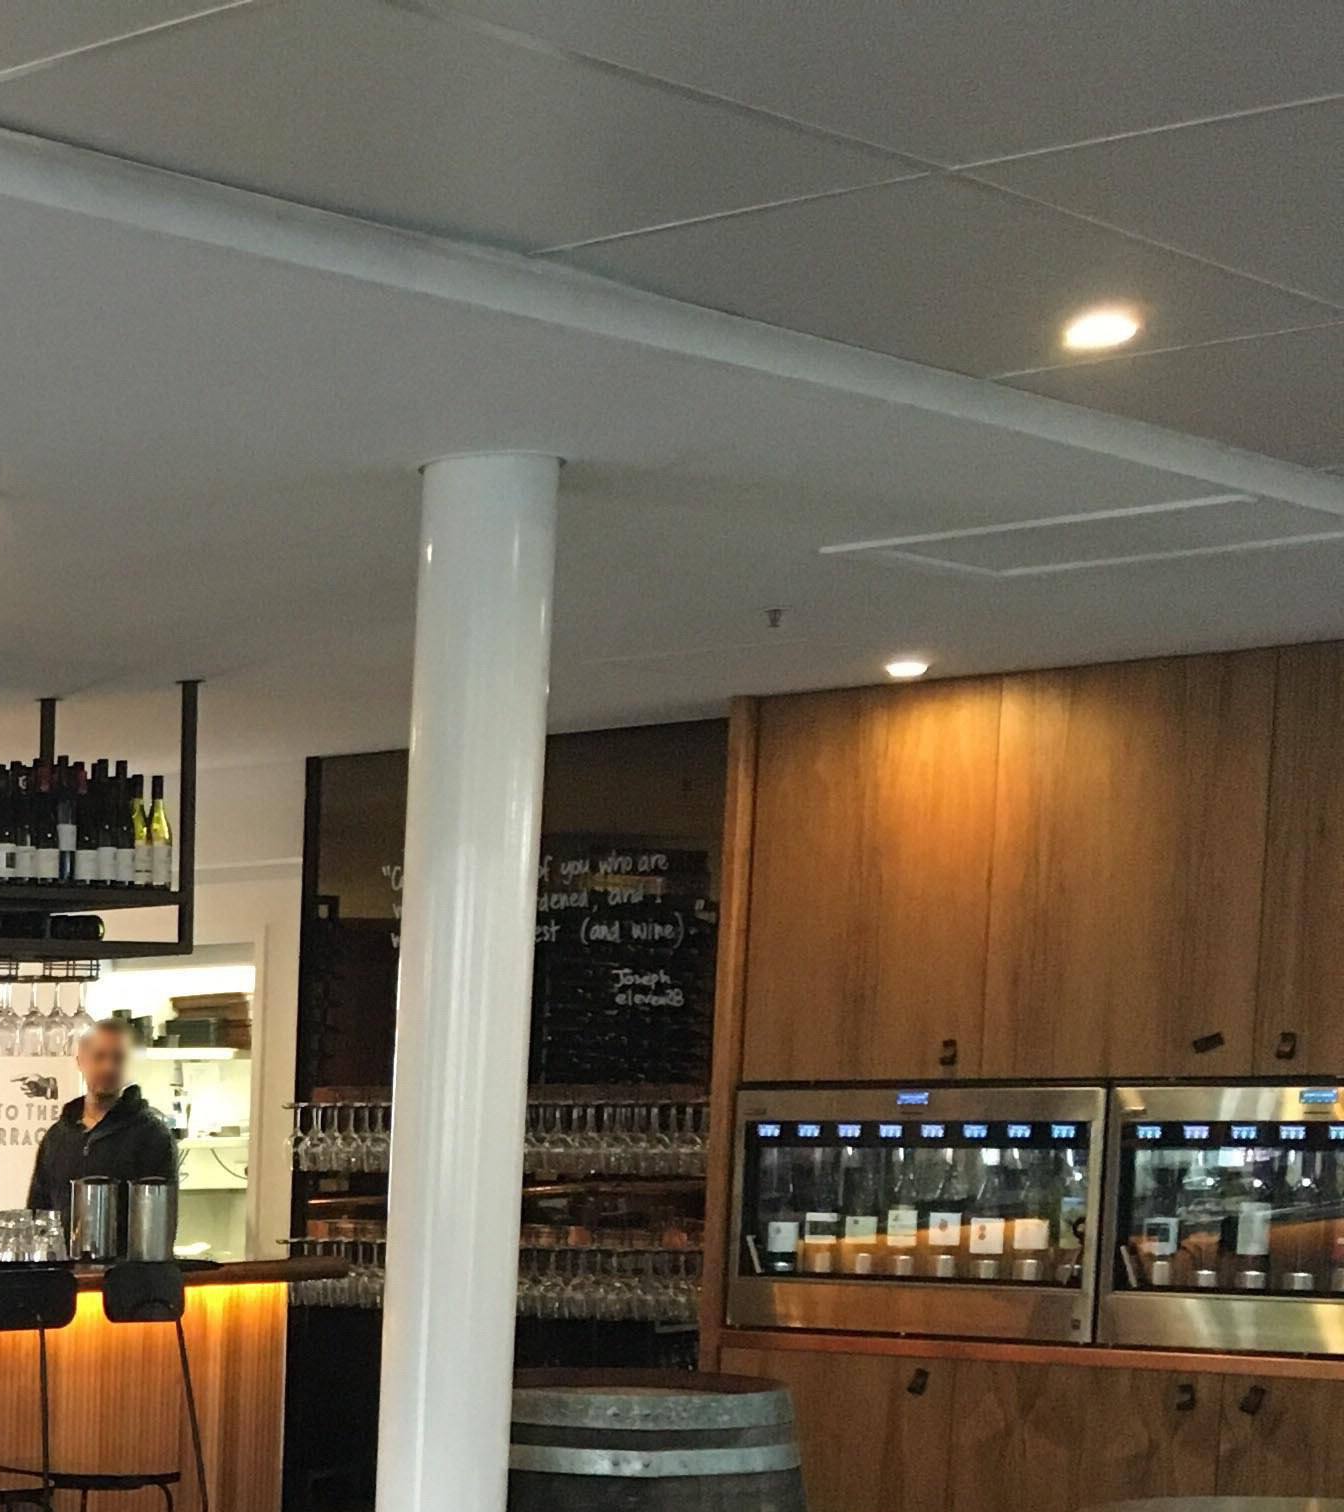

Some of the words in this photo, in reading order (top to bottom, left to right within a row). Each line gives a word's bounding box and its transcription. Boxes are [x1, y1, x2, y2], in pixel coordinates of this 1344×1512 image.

[560, 859, 590, 885] you
[598, 849, 633, 874] who
[637, 854, 670, 872] are
[537, 888, 598, 912] dened,
[608, 882, 644, 905] and
[535, 919, 561, 943] est
[580, 917, 621, 945] (and
[611, 968, 671, 990] Joseph
[26, 1103, 60, 1121] THE
